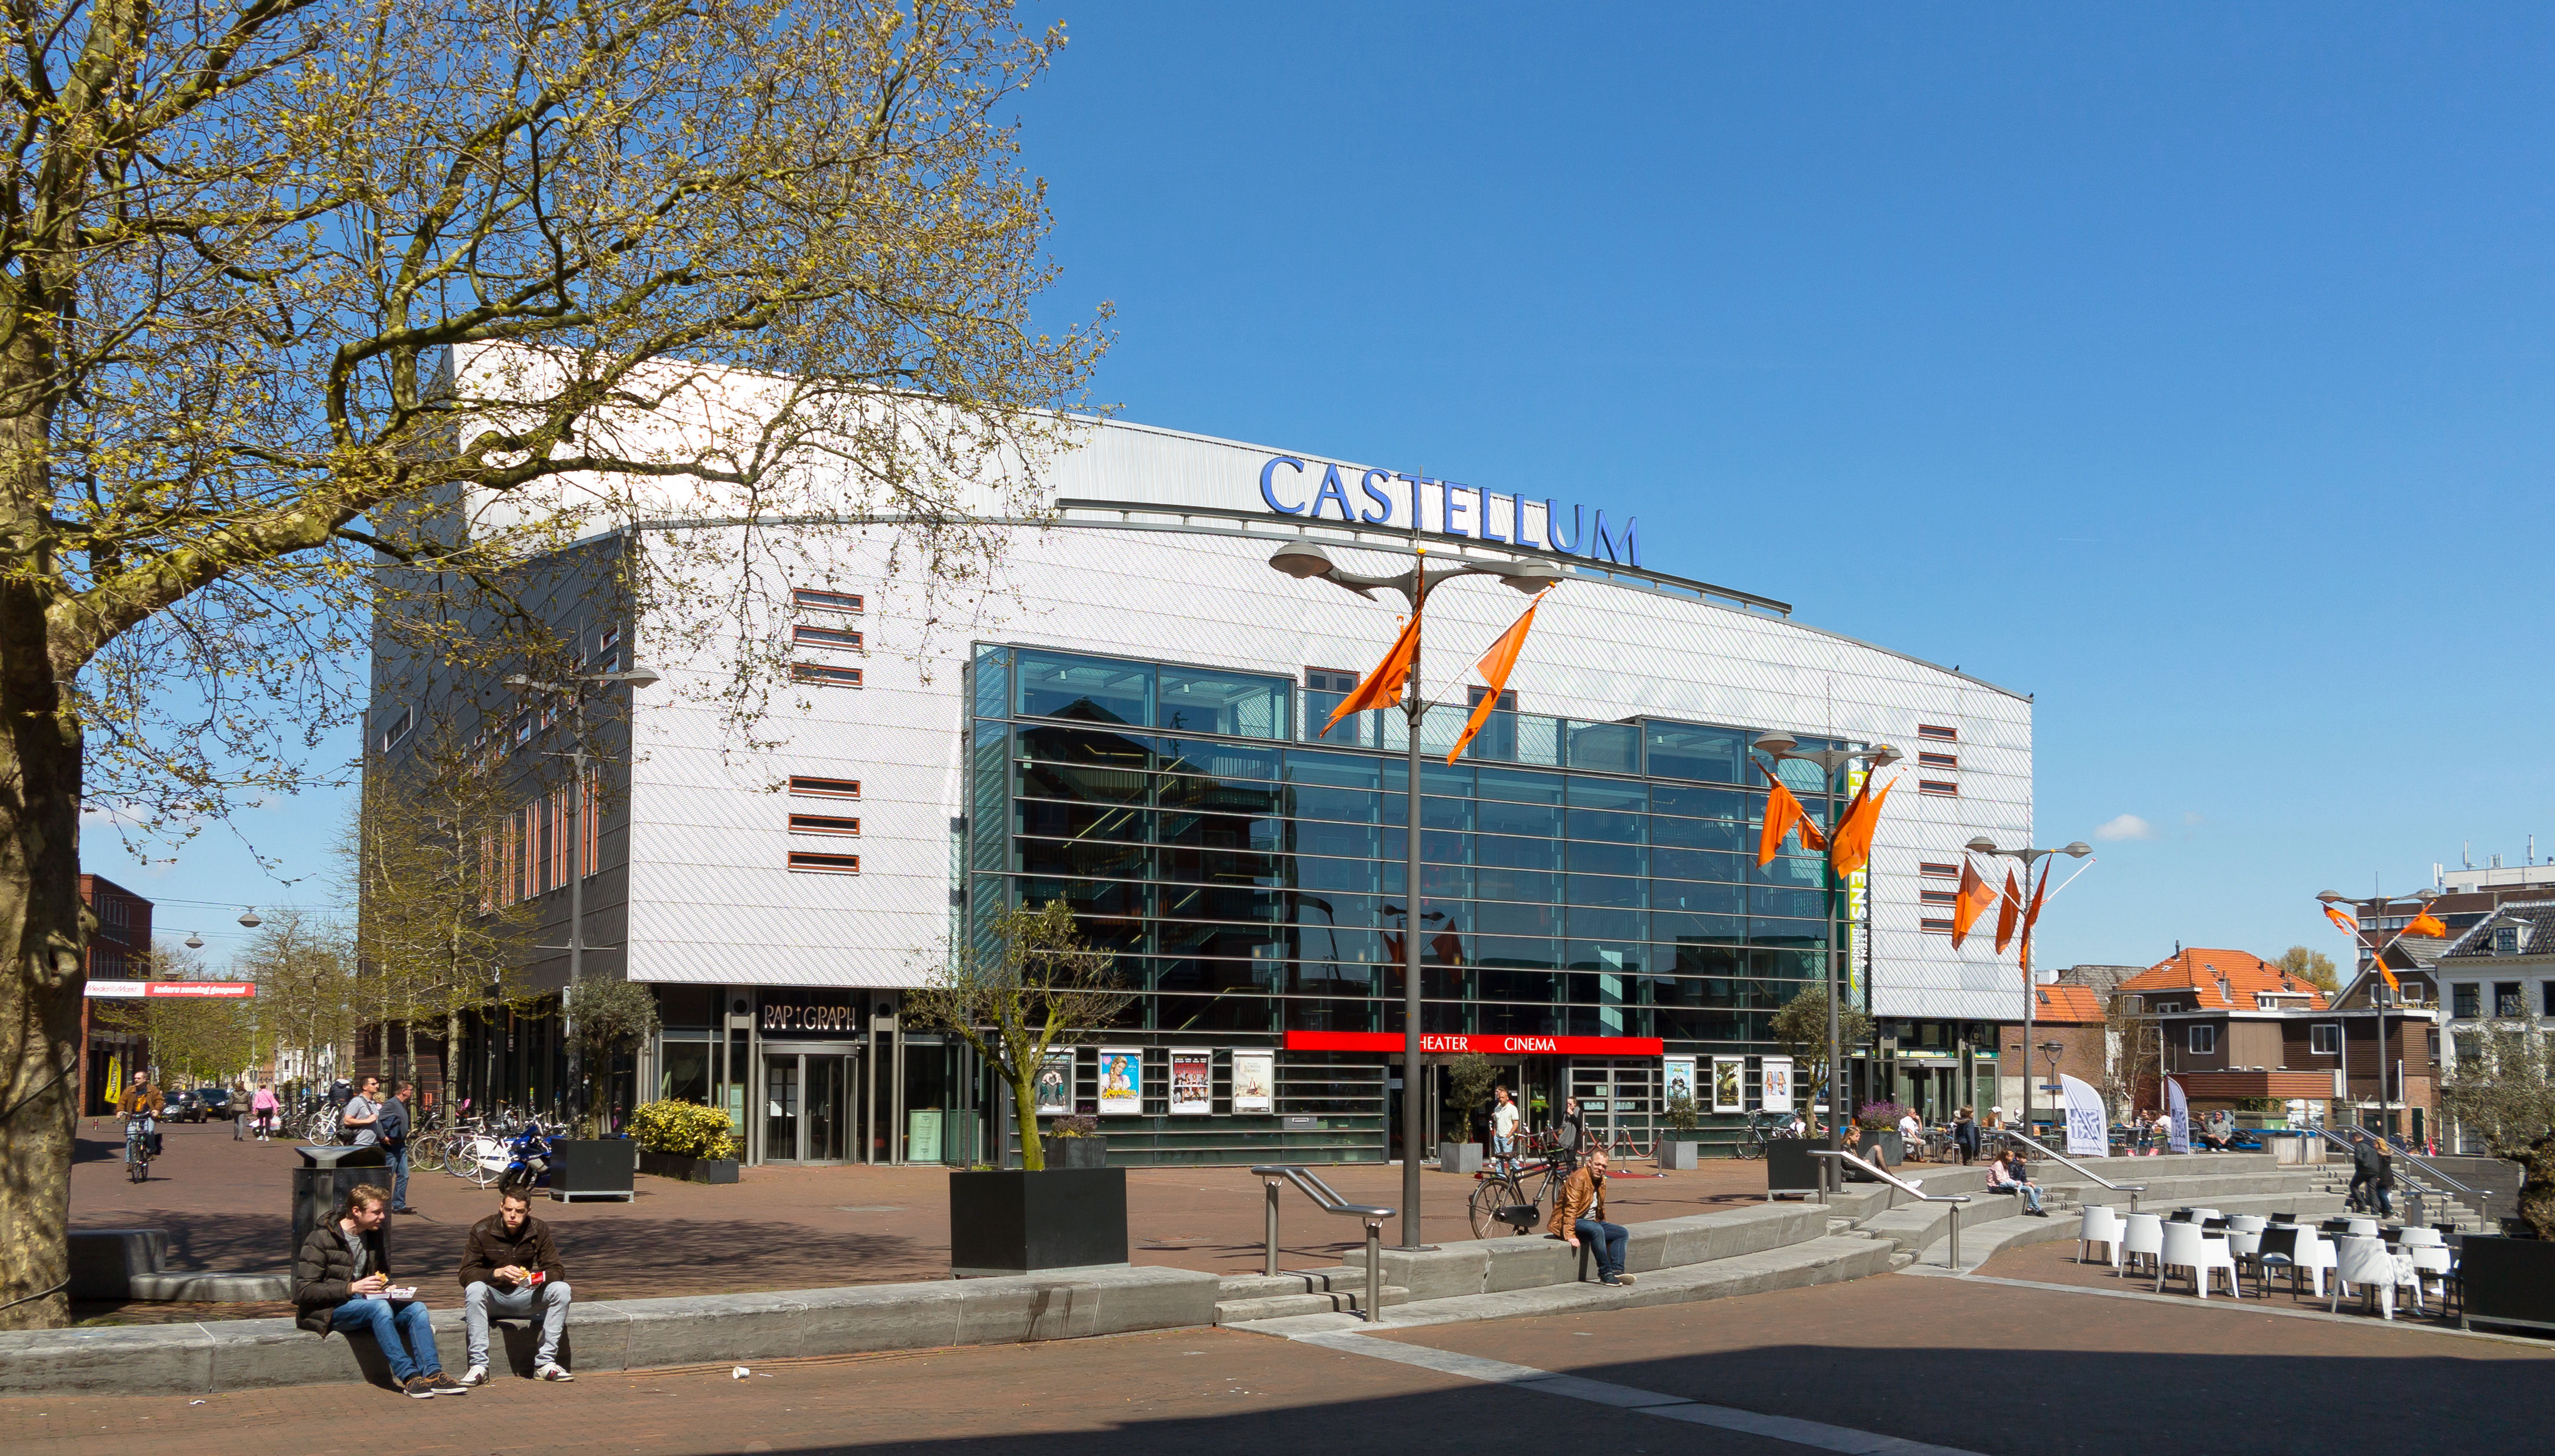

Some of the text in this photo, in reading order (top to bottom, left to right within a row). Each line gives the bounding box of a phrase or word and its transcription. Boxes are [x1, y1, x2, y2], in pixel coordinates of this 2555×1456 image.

[1260, 456, 1641, 568] CASTELLUM
[1852, 928, 1860, 976] DRINKEN
[153, 985, 245, 995] Iedere zondag geopend
[1420, 1036, 1468, 1050] HEATER
[1504, 1037, 1556, 1051] CINEMA
